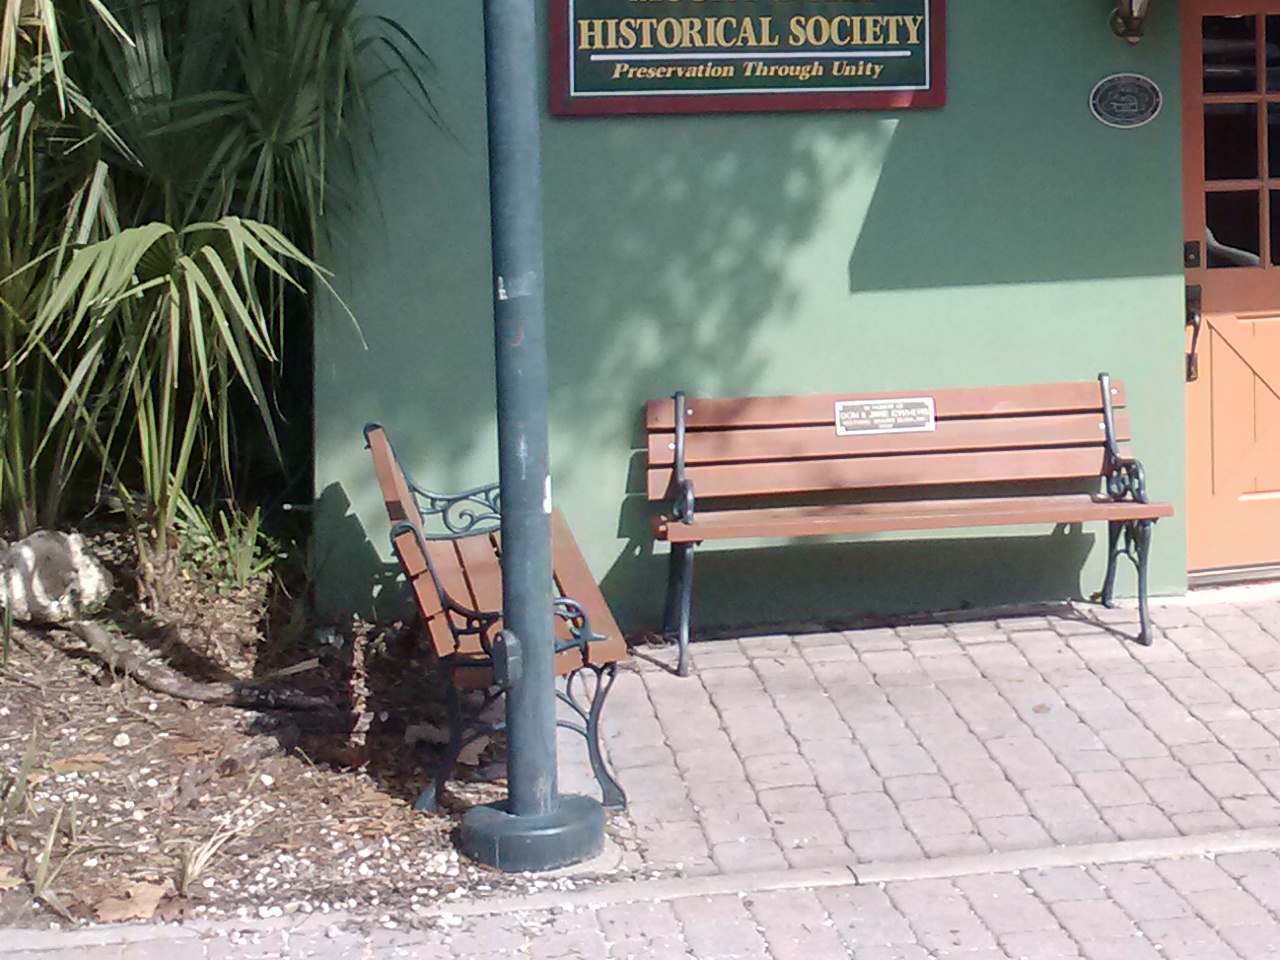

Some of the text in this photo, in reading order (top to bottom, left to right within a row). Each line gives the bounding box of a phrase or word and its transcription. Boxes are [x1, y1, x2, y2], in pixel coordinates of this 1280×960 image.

[577, 15, 924, 50] HISTORICAL SOCIETY
[612, 60, 884, 80] Preservation Through Unity
